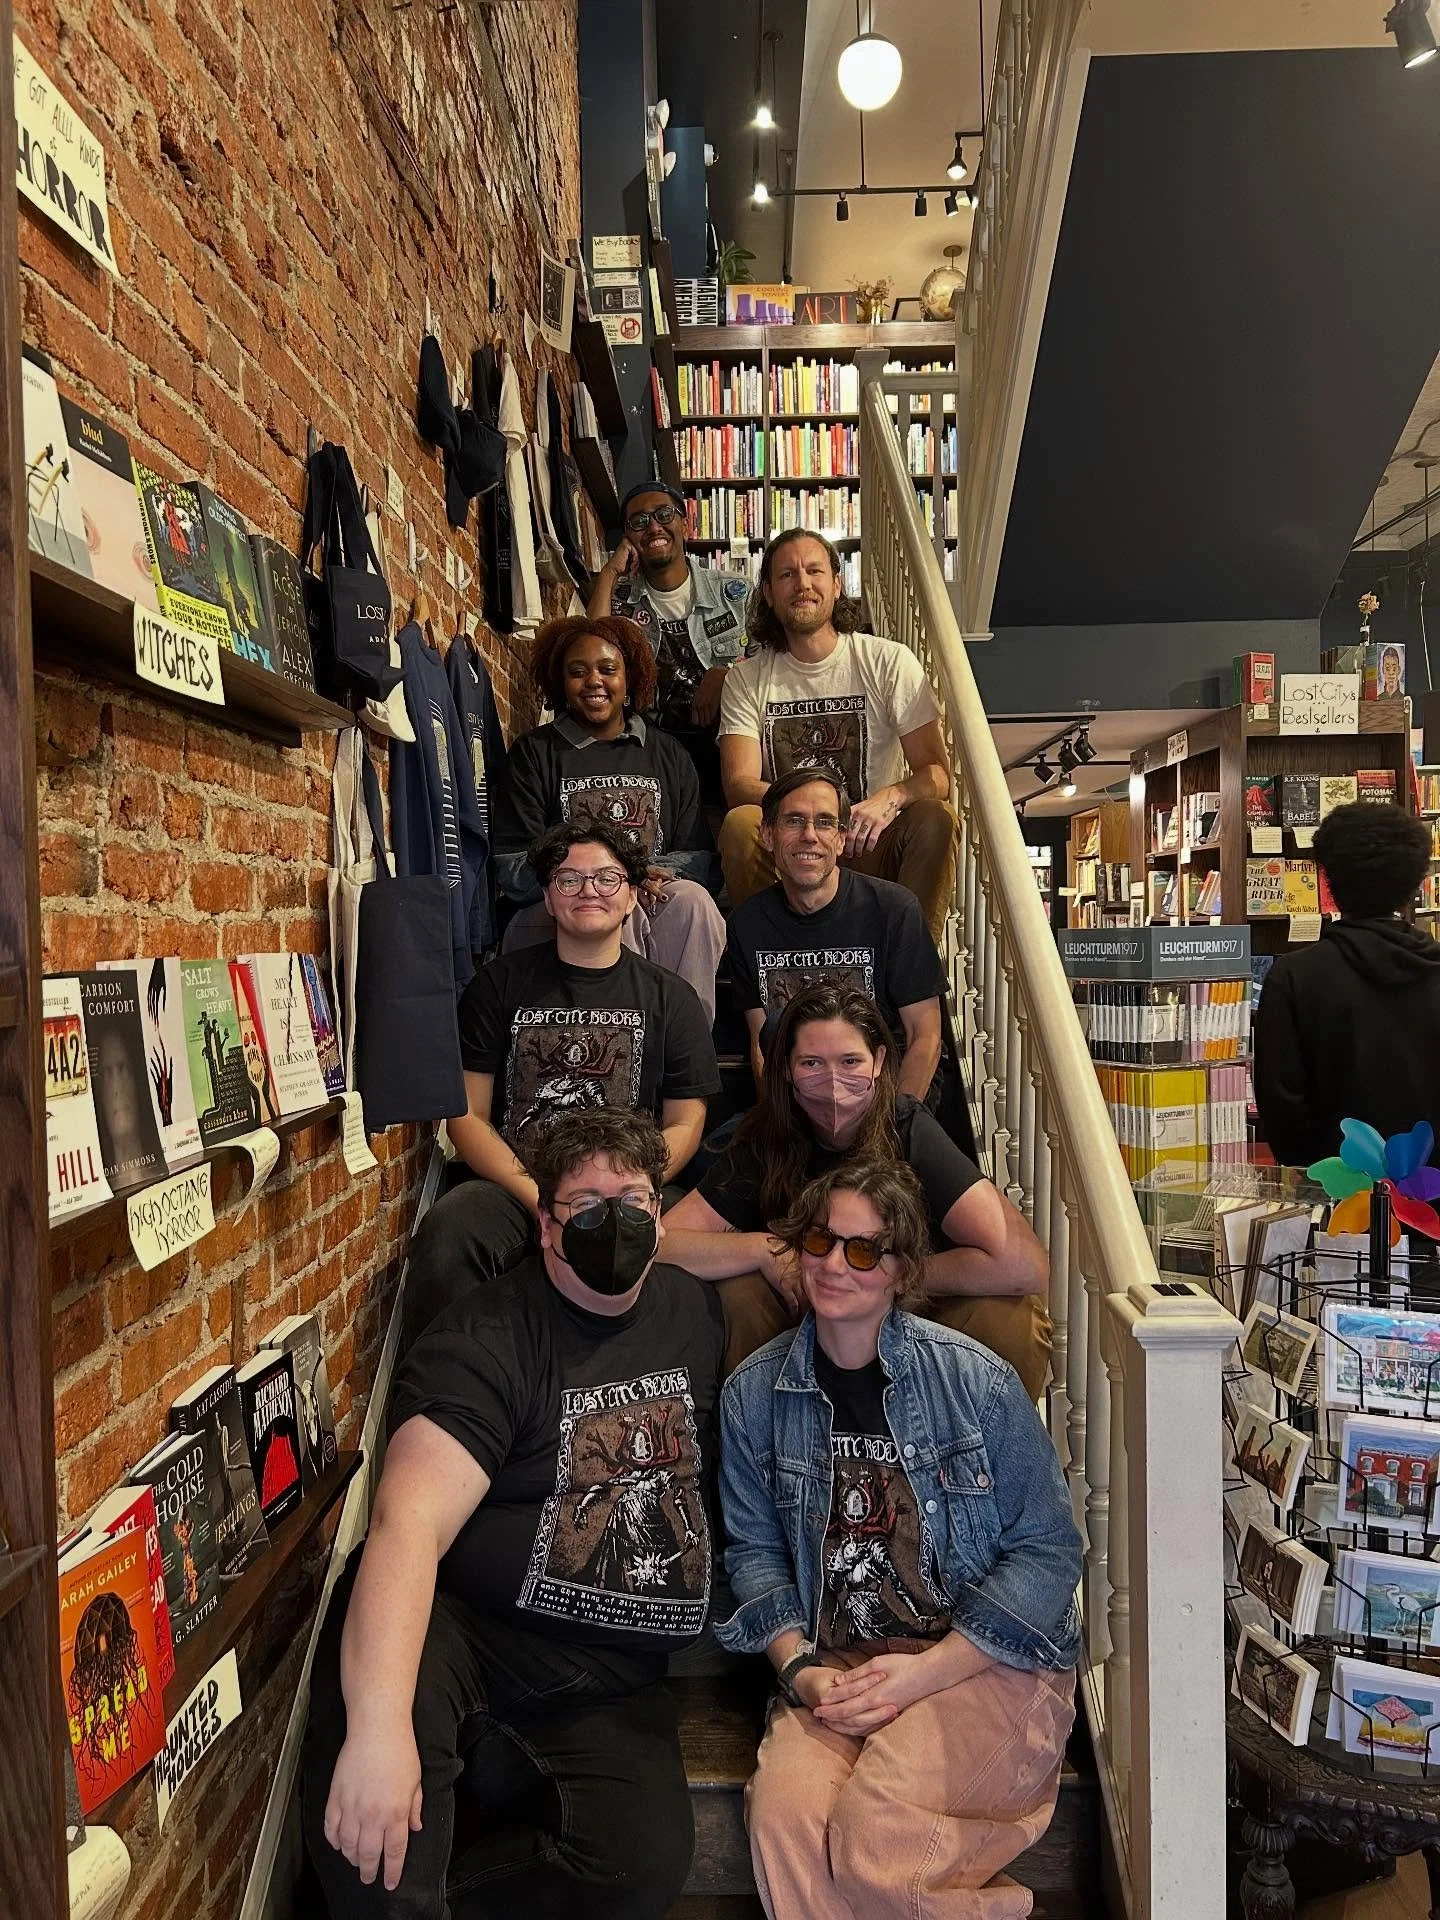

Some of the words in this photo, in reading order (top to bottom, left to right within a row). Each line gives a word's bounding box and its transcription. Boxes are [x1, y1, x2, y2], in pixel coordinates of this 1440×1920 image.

[29, 75, 48, 110] GOT
[17, 127, 112, 261] HORROR
[697, 278, 717, 324] MAGNUM
[801, 295, 848, 324] ART
[80, 417, 104, 446] blud
[272, 569, 302, 606] ROSE
[169, 597, 203, 619] EVERYONE
[202, 609, 227, 626] KNOWS
[172, 608, 195, 627] YOUR
[195, 618, 231, 638] MOTHER
[136, 616, 214, 693] WITCHES
[282, 644, 312, 677] ALEX
[766, 702, 796, 716] LOST
[797, 700, 822, 714] CITY
[824, 697, 864, 712] BOOKS
[1283, 682, 1319, 702] Lost
[562, 778, 592, 793] LOST
[594, 776, 620, 789] CITY
[622, 776, 658, 791] BOOKS
[1361, 788, 1395, 796] POTOMAC
[1287, 812, 1314, 821] BABEL
[1284, 860, 1316, 874] Martyr!
[1246, 877, 1281, 887] GREAT
[1251, 890, 1284, 900] RIVER
[758, 952, 792, 968] LOST
[793, 951, 822, 967] CITY
[823, 949, 871, 966] BOOKS
[1064, 942, 1138, 955] LEUCHTTURM1917
[1159, 940, 1237, 955] LEUCHTTURM1917
[80, 982, 122, 998] CARRION
[184, 967, 212, 987] SALT
[274, 977, 288, 990] MY
[88, 999, 135, 1016] COMFORT
[195, 986, 220, 1000] GROWS
[205, 998, 233, 1015] HEAVY
[271, 996, 298, 1011] HEART
[280, 1018, 288, 1030] IS
[513, 1009, 553, 1025] LOST
[555, 1009, 587, 1025] CITY
[588, 1010, 642, 1027] BOOKS
[48, 1033, 86, 1083] 4A2
[273, 1048, 315, 1068] CHAINSAW
[57, 1146, 99, 1192] HILL
[104, 1166, 120, 1178] DAN
[121, 1153, 156, 1171] SIMMONS
[161, 1172, 208, 1217] OCTANE
[209, 1375, 233, 1410] CASSIDY
[254, 1371, 289, 1409] RICHARD
[565, 1387, 605, 1415] LOST
[608, 1381, 640, 1409] CITY
[640, 1371, 687, 1399] BOOKS
[253, 1386, 294, 1452] MATHESON
[864, 1437, 899, 1463] BOO
[151, 1480, 166, 1499] THE
[166, 1446, 203, 1491] COLD
[155, 1469, 205, 1528] HOUSE
[60, 1581, 94, 1611] ARAH
[97, 1552, 138, 1587] GAILEY
[185, 1594, 219, 1633] SLATTER
[69, 1667, 148, 1745] SPREAD
[102, 1722, 131, 1763] ME
[155, 1680, 219, 1794] HAUNTED
[167, 1707, 222, 1800] HOUSES
